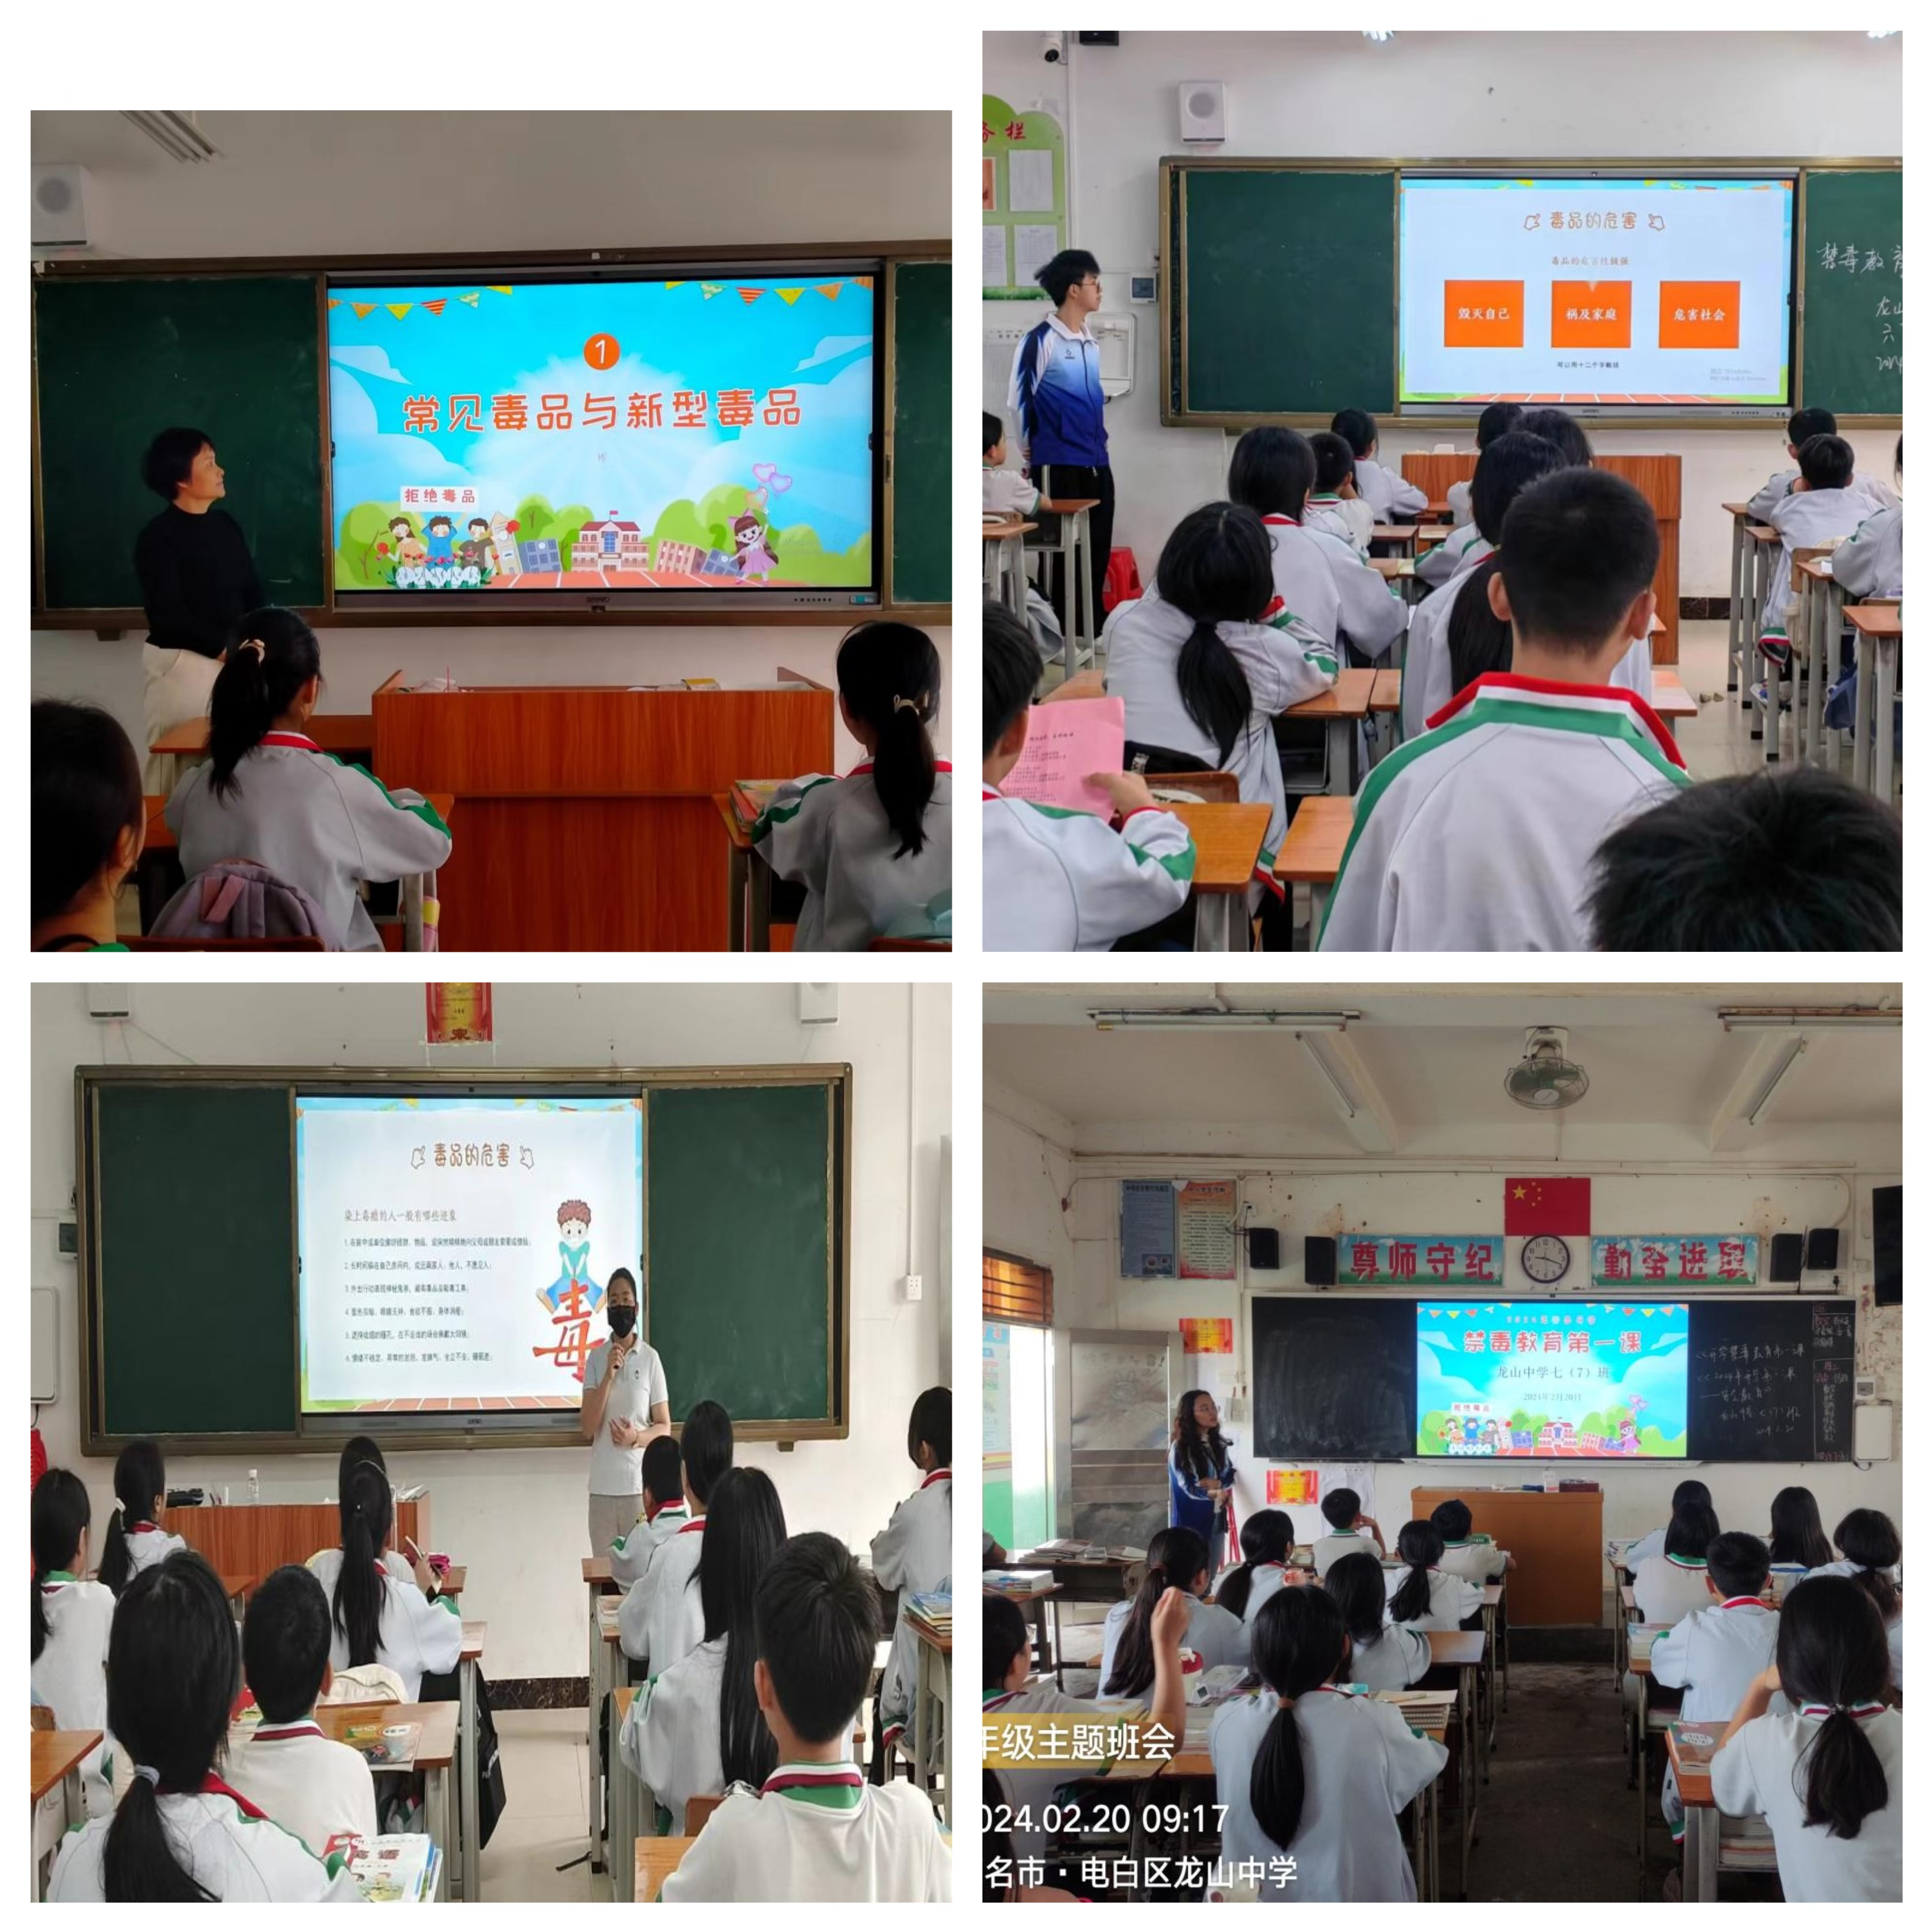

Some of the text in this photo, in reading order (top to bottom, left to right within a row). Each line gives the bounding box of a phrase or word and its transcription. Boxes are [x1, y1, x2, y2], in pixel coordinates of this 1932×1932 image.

[1549, 211, 1638, 230] 毒品的危害
[1457, 307, 1510, 321] 毁灭自己
[1565, 307, 1618, 321] 祸及家庭
[1673, 308, 1727, 322] 危害社会
[593, 339, 607, 364] 1
[402, 388, 803, 433] 常见毒品与新型毒品
[404, 488, 476, 504] 拒绝毒品
[433, 1142, 510, 1168] 毒品的危害
[1351, 1241, 1495, 1281] 尊师守纪
[533, 1278, 606, 1384] 毒
[1463, 1330, 1642, 1353] 禁毒教育第一课
